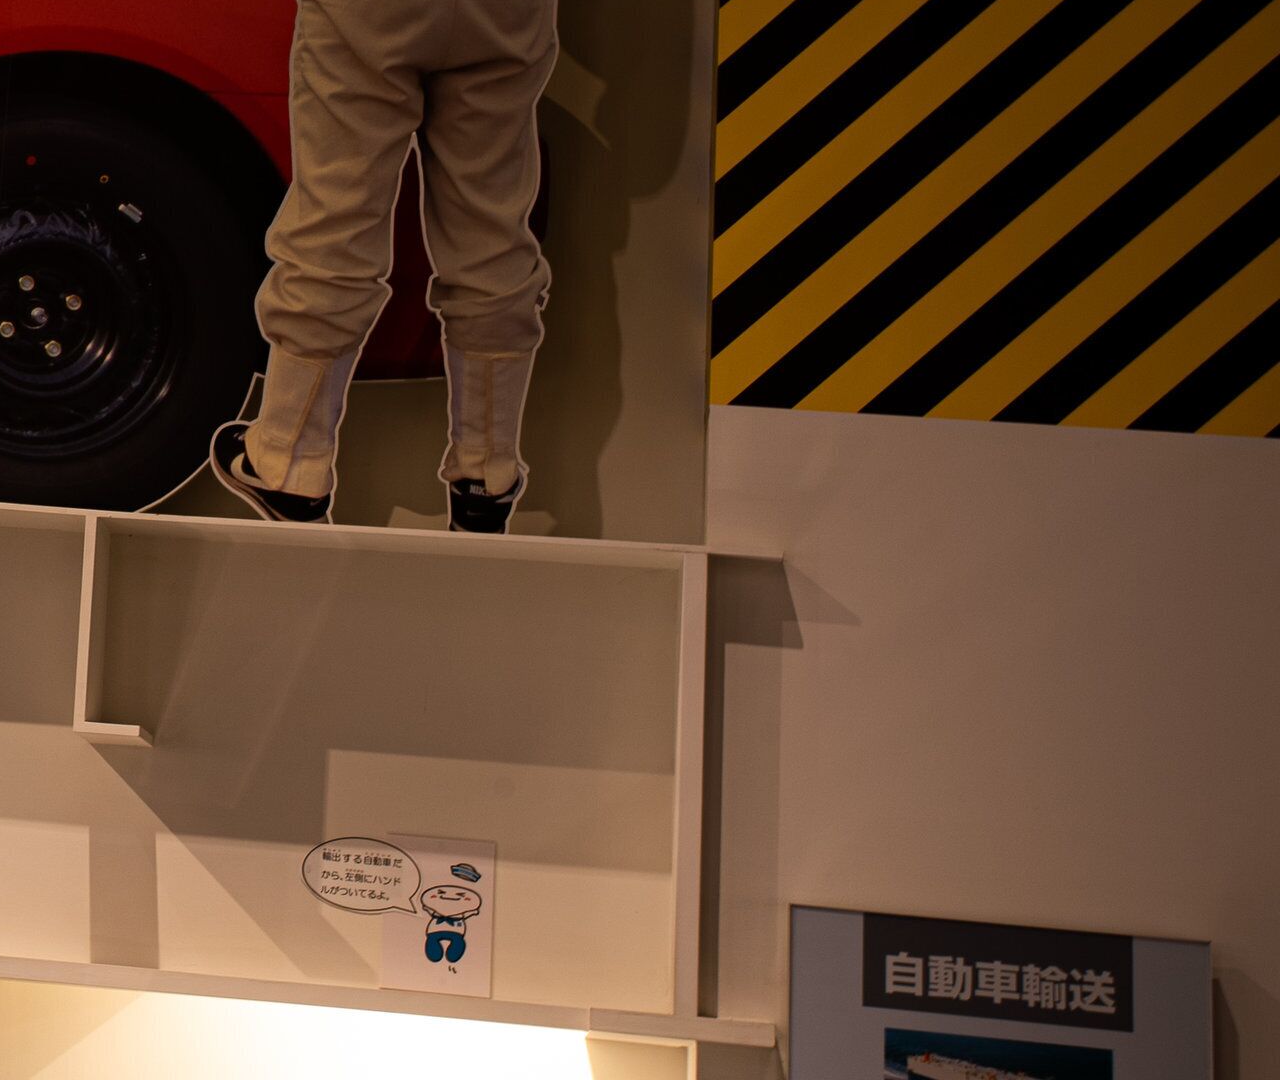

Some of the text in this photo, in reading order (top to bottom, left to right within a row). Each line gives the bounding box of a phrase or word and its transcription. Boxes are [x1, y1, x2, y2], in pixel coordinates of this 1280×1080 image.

[320, 870, 402, 887] から、左側にハンド
[320, 885, 391, 901] ルがついてるよ。
[883, 951, 1117, 1015] 自動車輸送
